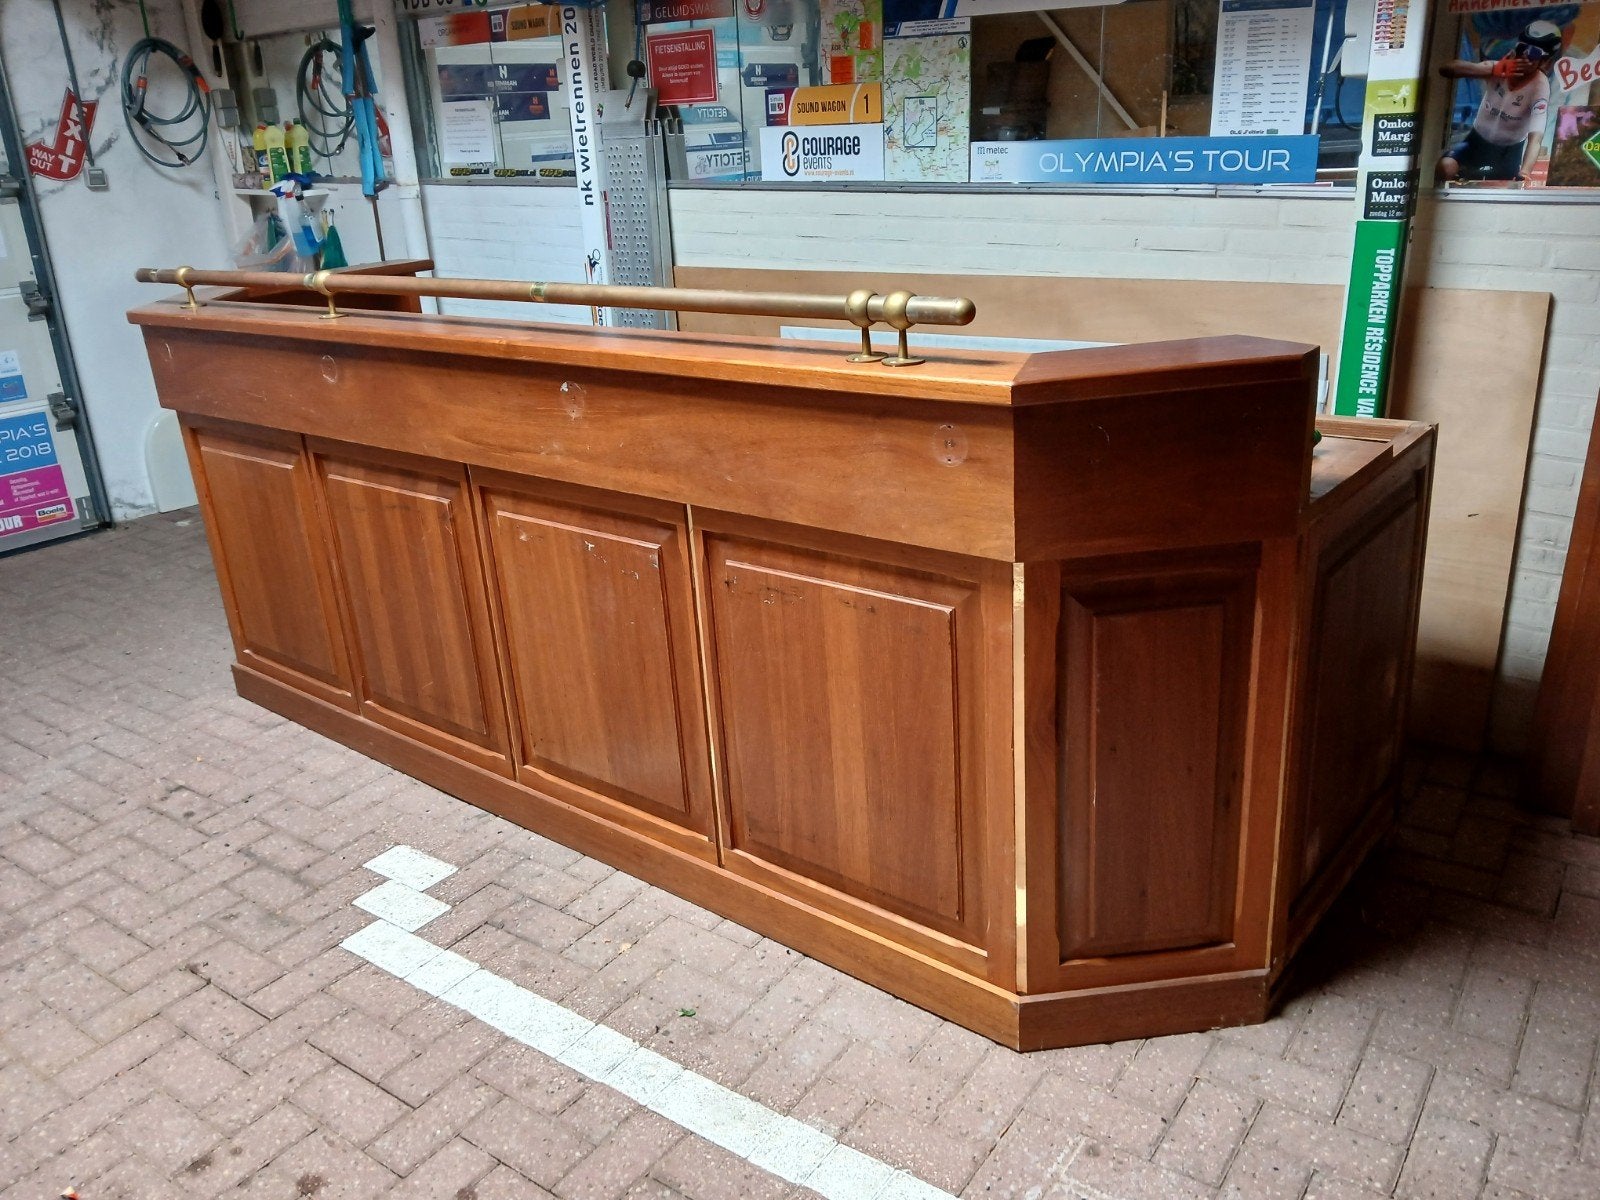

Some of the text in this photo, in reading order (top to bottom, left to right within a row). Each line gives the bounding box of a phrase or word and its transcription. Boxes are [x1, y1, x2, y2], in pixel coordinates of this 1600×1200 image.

[655, 41, 706, 54] FIETSENSTALLING
[569, 42, 591, 173] wielrennen
[797, 93, 869, 114] SOUND WAGON 1
[58, 102, 87, 173] EXIT
[802, 135, 861, 156] COURAGE
[32, 147, 55, 163] WAY
[986, 147, 1009, 155] metec
[1039, 149, 1290, 173] OLYMPIA'S TOUR
[30, 158, 52, 171] OUT
[803, 156, 832, 170] events
[581, 180, 594, 206] nk
[1388, 209, 1396, 217] 12
[1367, 248, 1395, 324] TOPPARKEN
[1358, 326, 1387, 396] RÉSIDENCE
[5, 442, 52, 462] 2018
[38, 506, 65, 517] Boels
